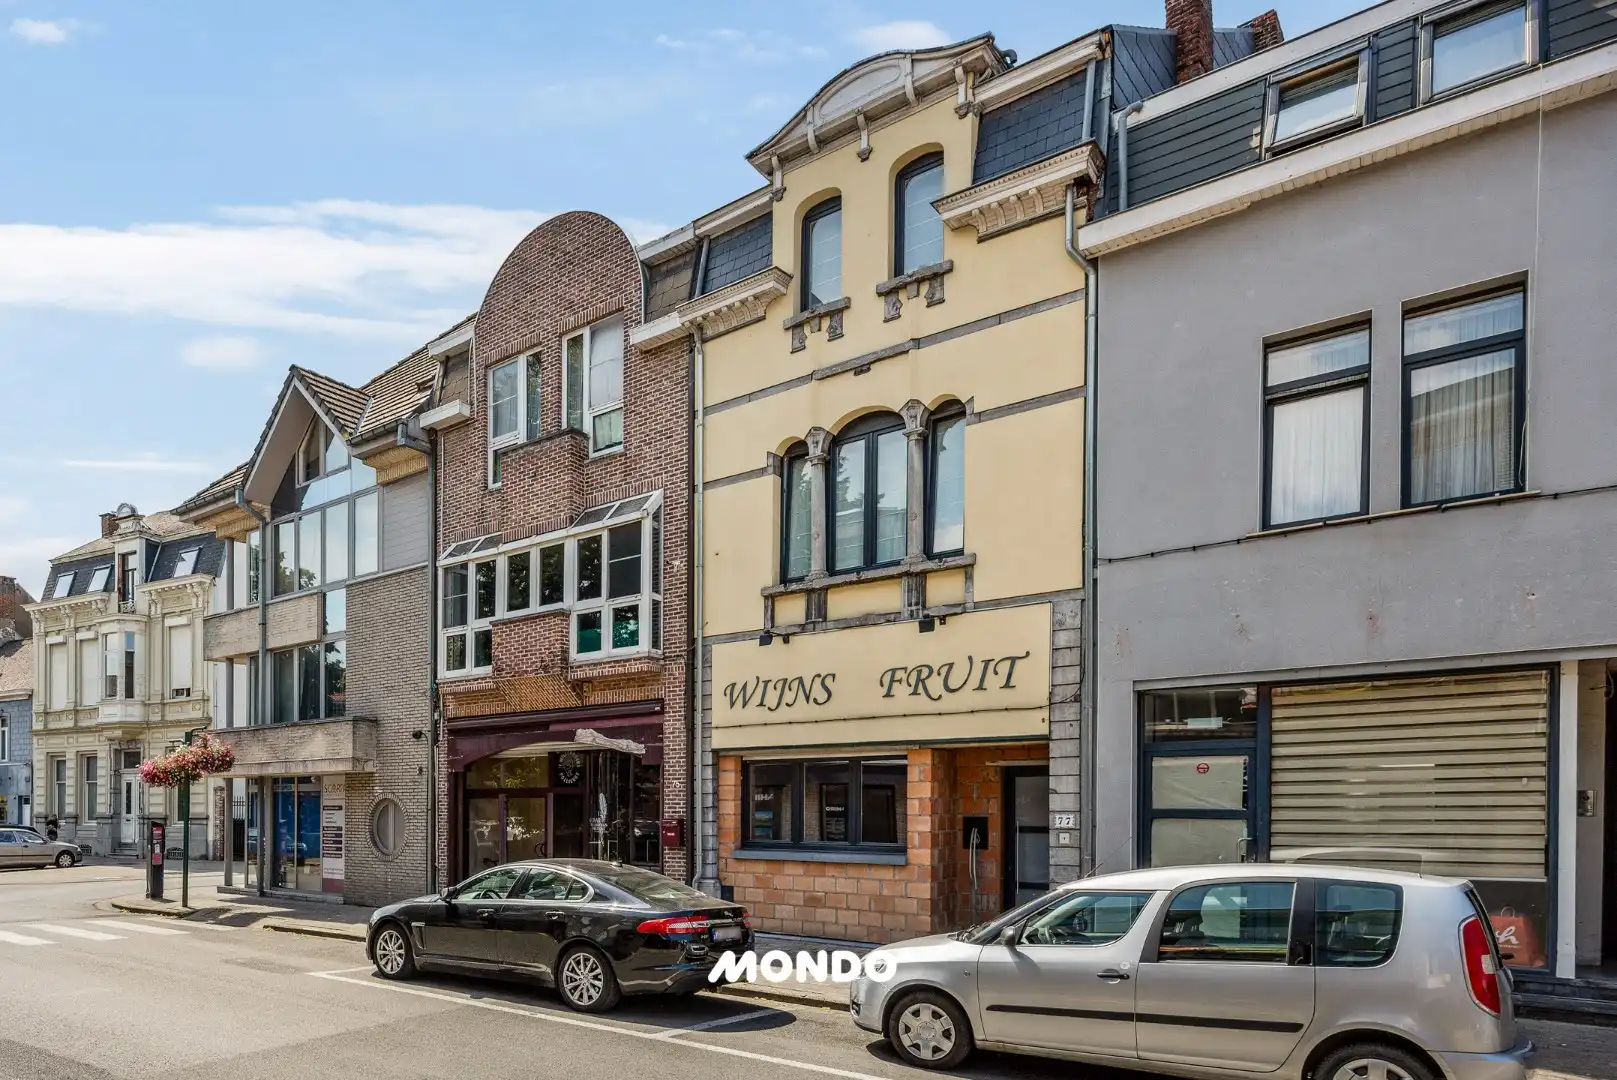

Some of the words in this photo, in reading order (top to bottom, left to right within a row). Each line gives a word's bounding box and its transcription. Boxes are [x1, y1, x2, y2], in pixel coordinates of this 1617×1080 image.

[724, 673, 836, 712] WIJNS
[880, 650, 1031, 701] FRUIT
[1058, 816, 1071, 826] 77
